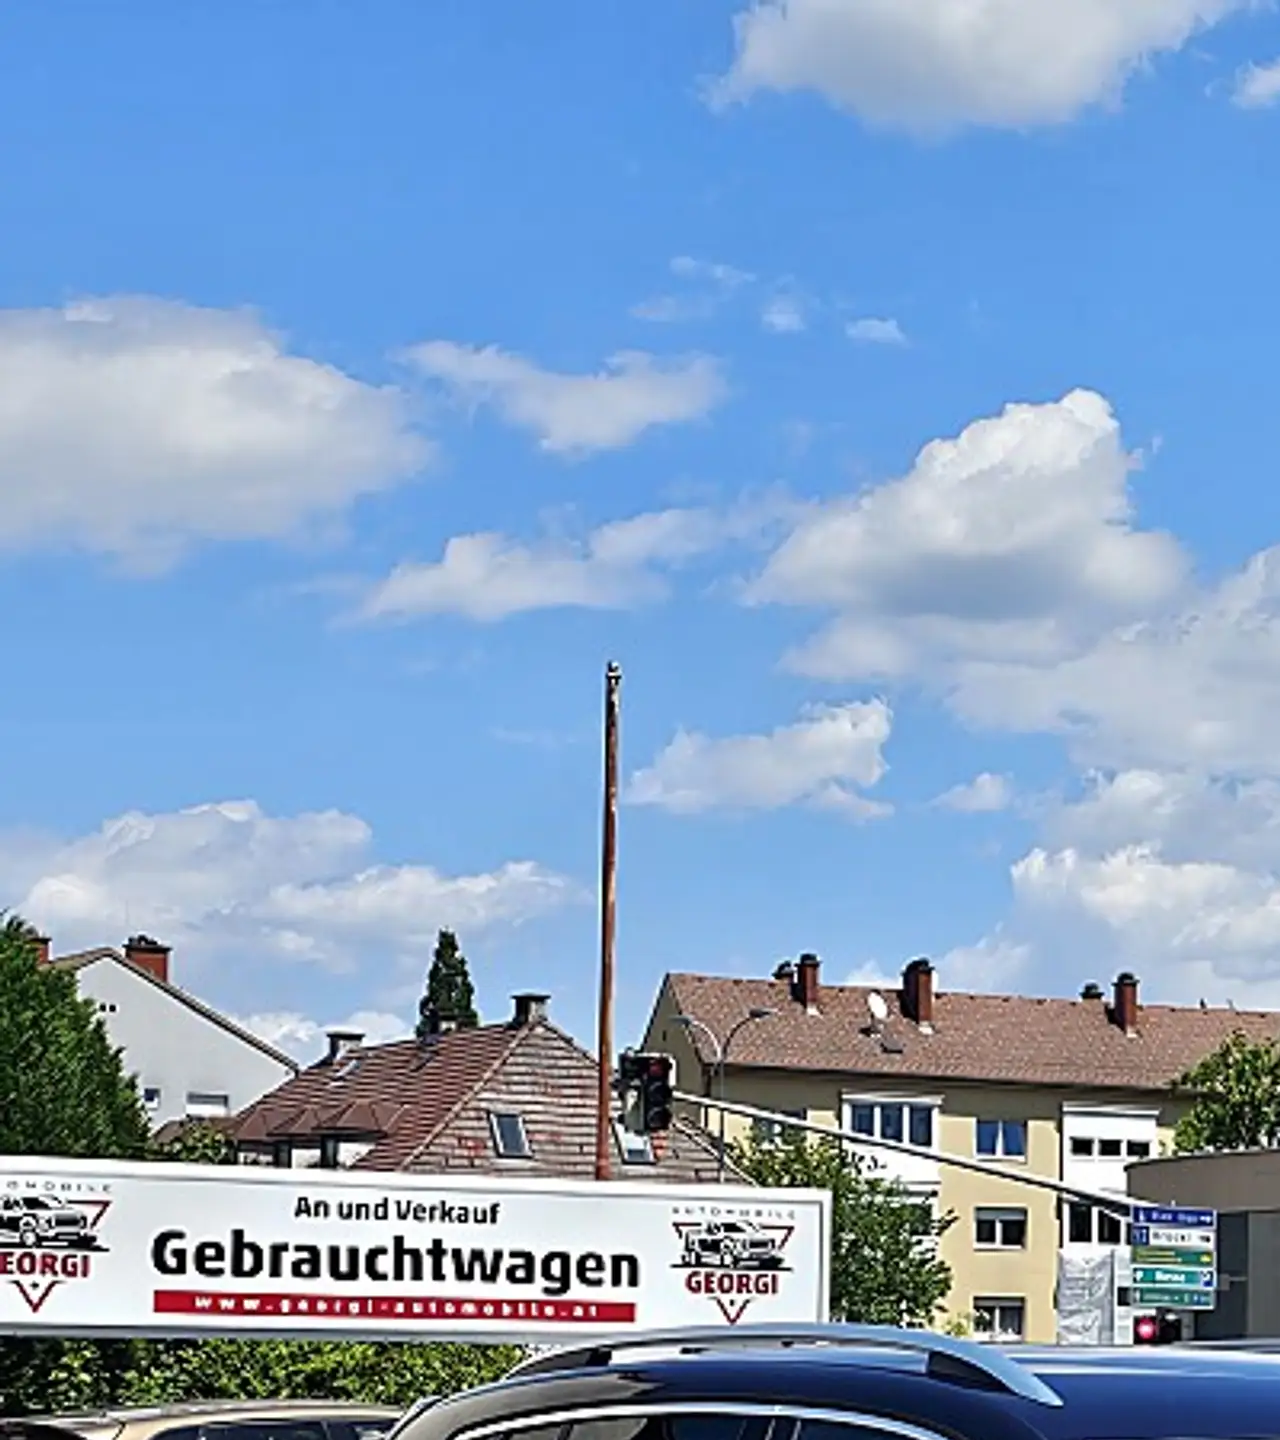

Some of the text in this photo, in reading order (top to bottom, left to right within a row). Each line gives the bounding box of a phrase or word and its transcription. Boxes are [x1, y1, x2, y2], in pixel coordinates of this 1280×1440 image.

[294, 1196, 501, 1225] An und Verkauf
[152, 1228, 639, 1296] Gebrauchtwagen
[685, 1270, 779, 1295] GEORGI
